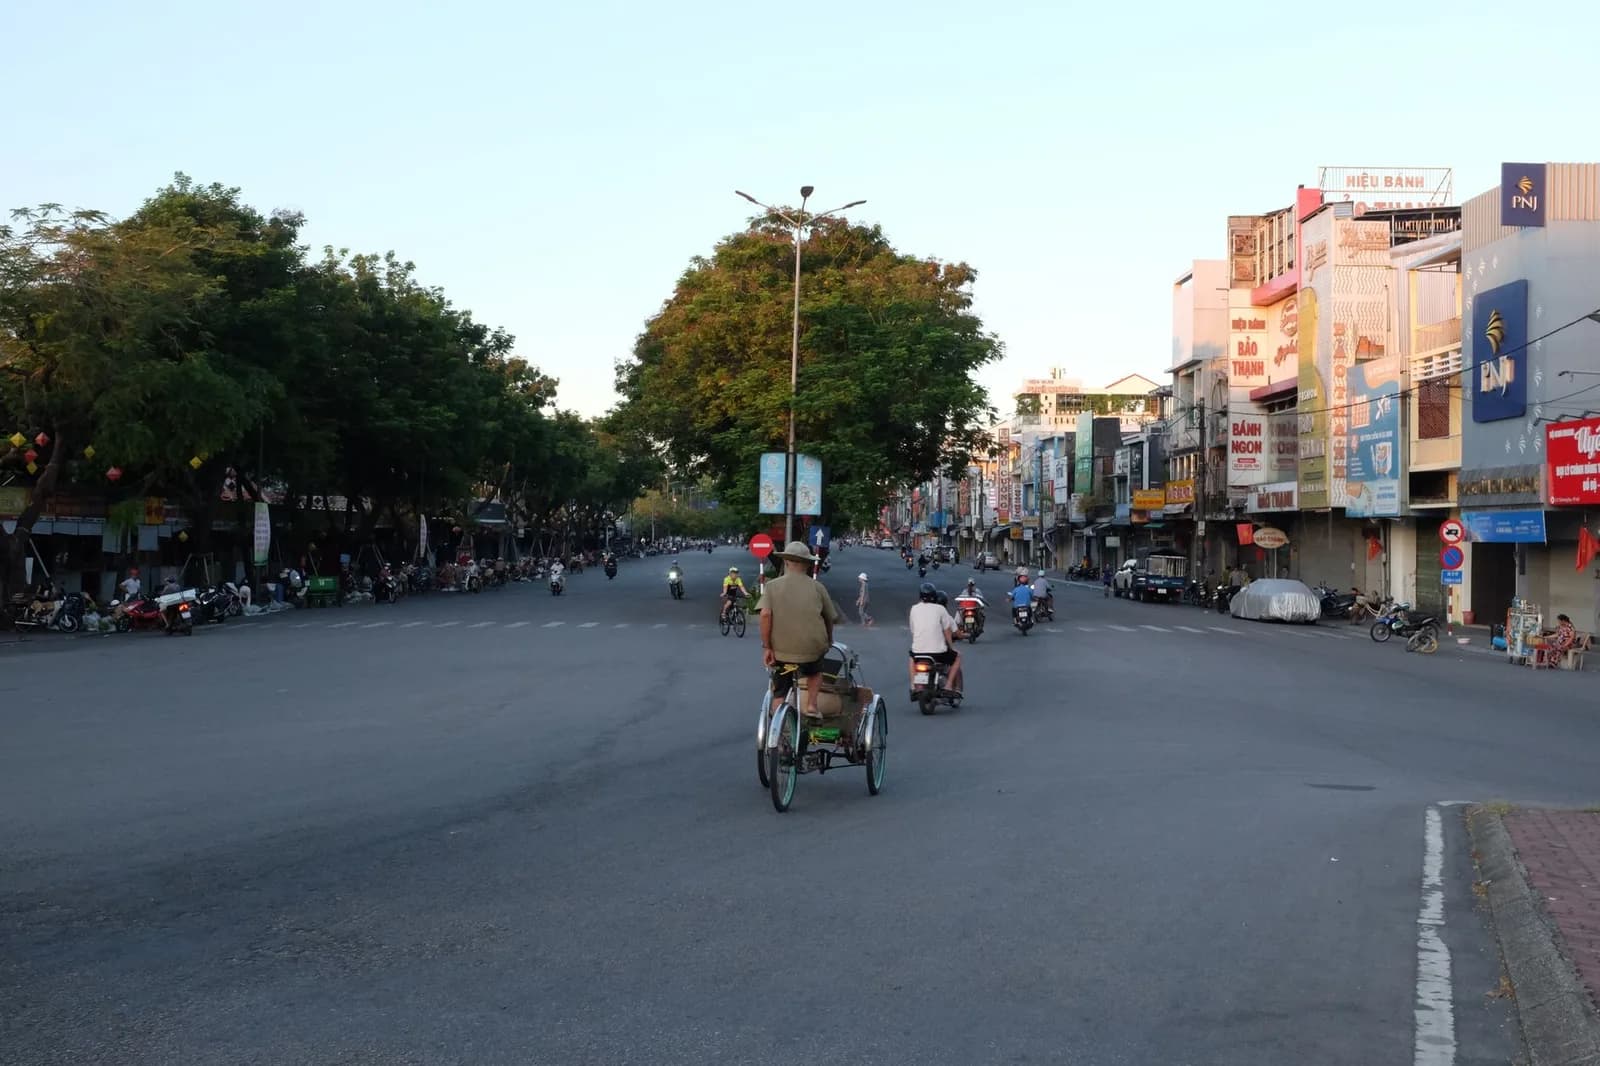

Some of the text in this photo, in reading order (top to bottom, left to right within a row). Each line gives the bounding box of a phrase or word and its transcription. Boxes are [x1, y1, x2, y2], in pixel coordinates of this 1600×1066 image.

[1346, 172, 1424, 190] HIỆU BÁNH
[1512, 195, 1538, 212] PNJ
[1238, 335, 1257, 356] BẢO
[1232, 361, 1264, 380] THẠNH
[1480, 356, 1514, 397] PNJ
[1232, 420, 1261, 436] BÁNH
[1231, 441, 1261, 454] NGON
